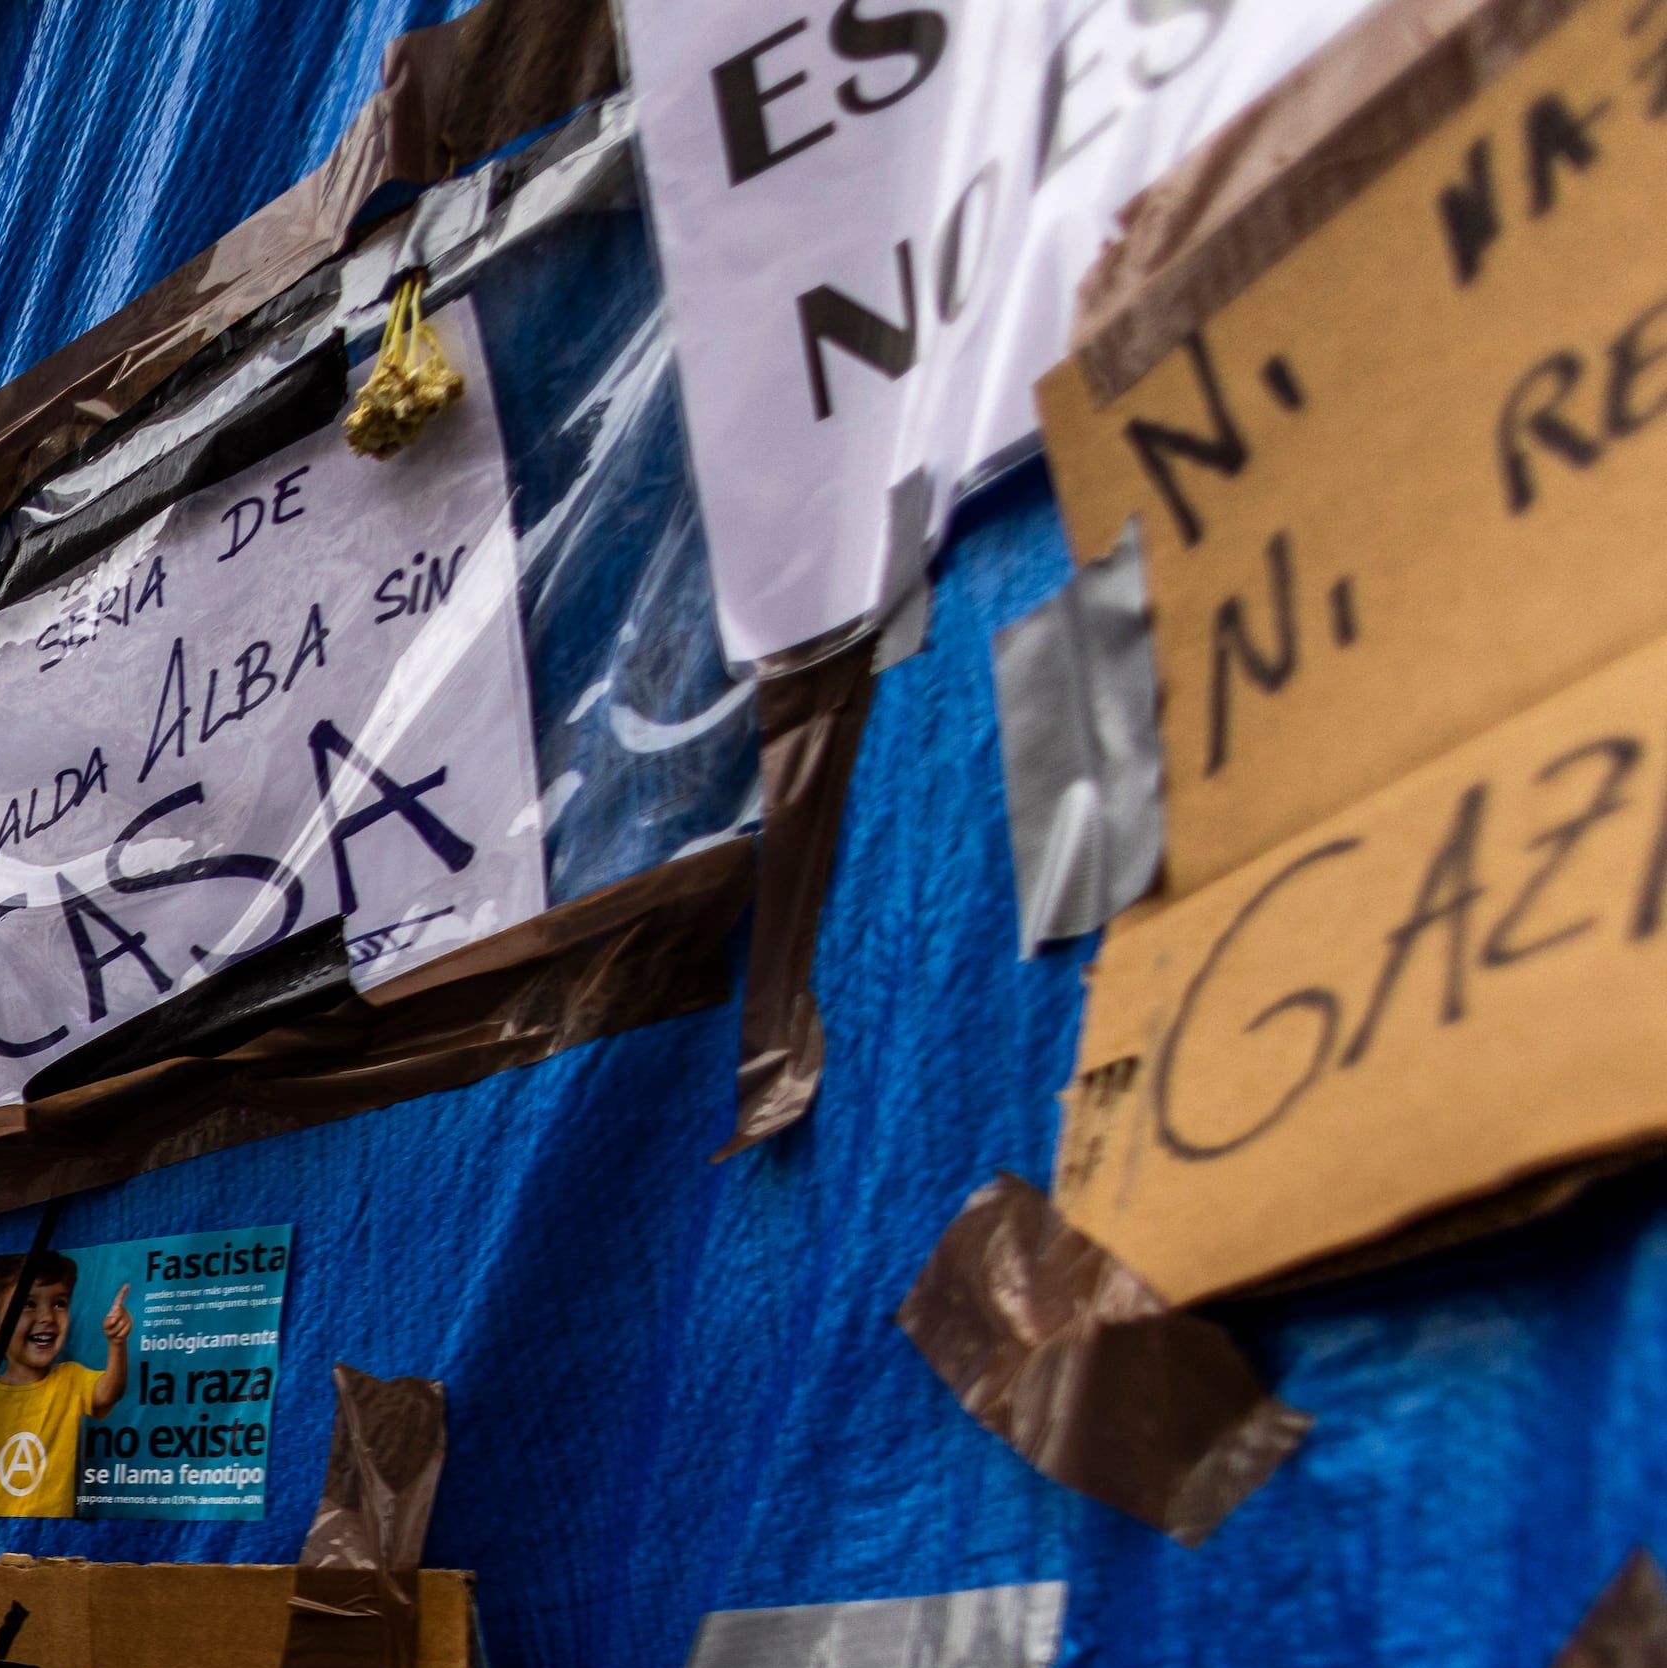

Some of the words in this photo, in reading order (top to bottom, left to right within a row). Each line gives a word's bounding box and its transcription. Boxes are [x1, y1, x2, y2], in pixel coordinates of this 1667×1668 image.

[709, 0, 949, 188] ES
[797, 155, 1000, 421] NO
[218, 465, 310, 563] DE
[140, 603, 330, 782] ALBA
[146, 1241, 286, 1283] Fascista
[140, 1329, 279, 1355] biológicamente
[138, 1361, 175, 1406] la
[186, 1366, 273, 1405] raza
[85, 1424, 140, 1460] no
[149, 1413, 267, 1459] existe
[83, 1465, 109, 1485] se
[113, 1462, 174, 1485] llama
[179, 1461, 265, 1490] fenotipo
